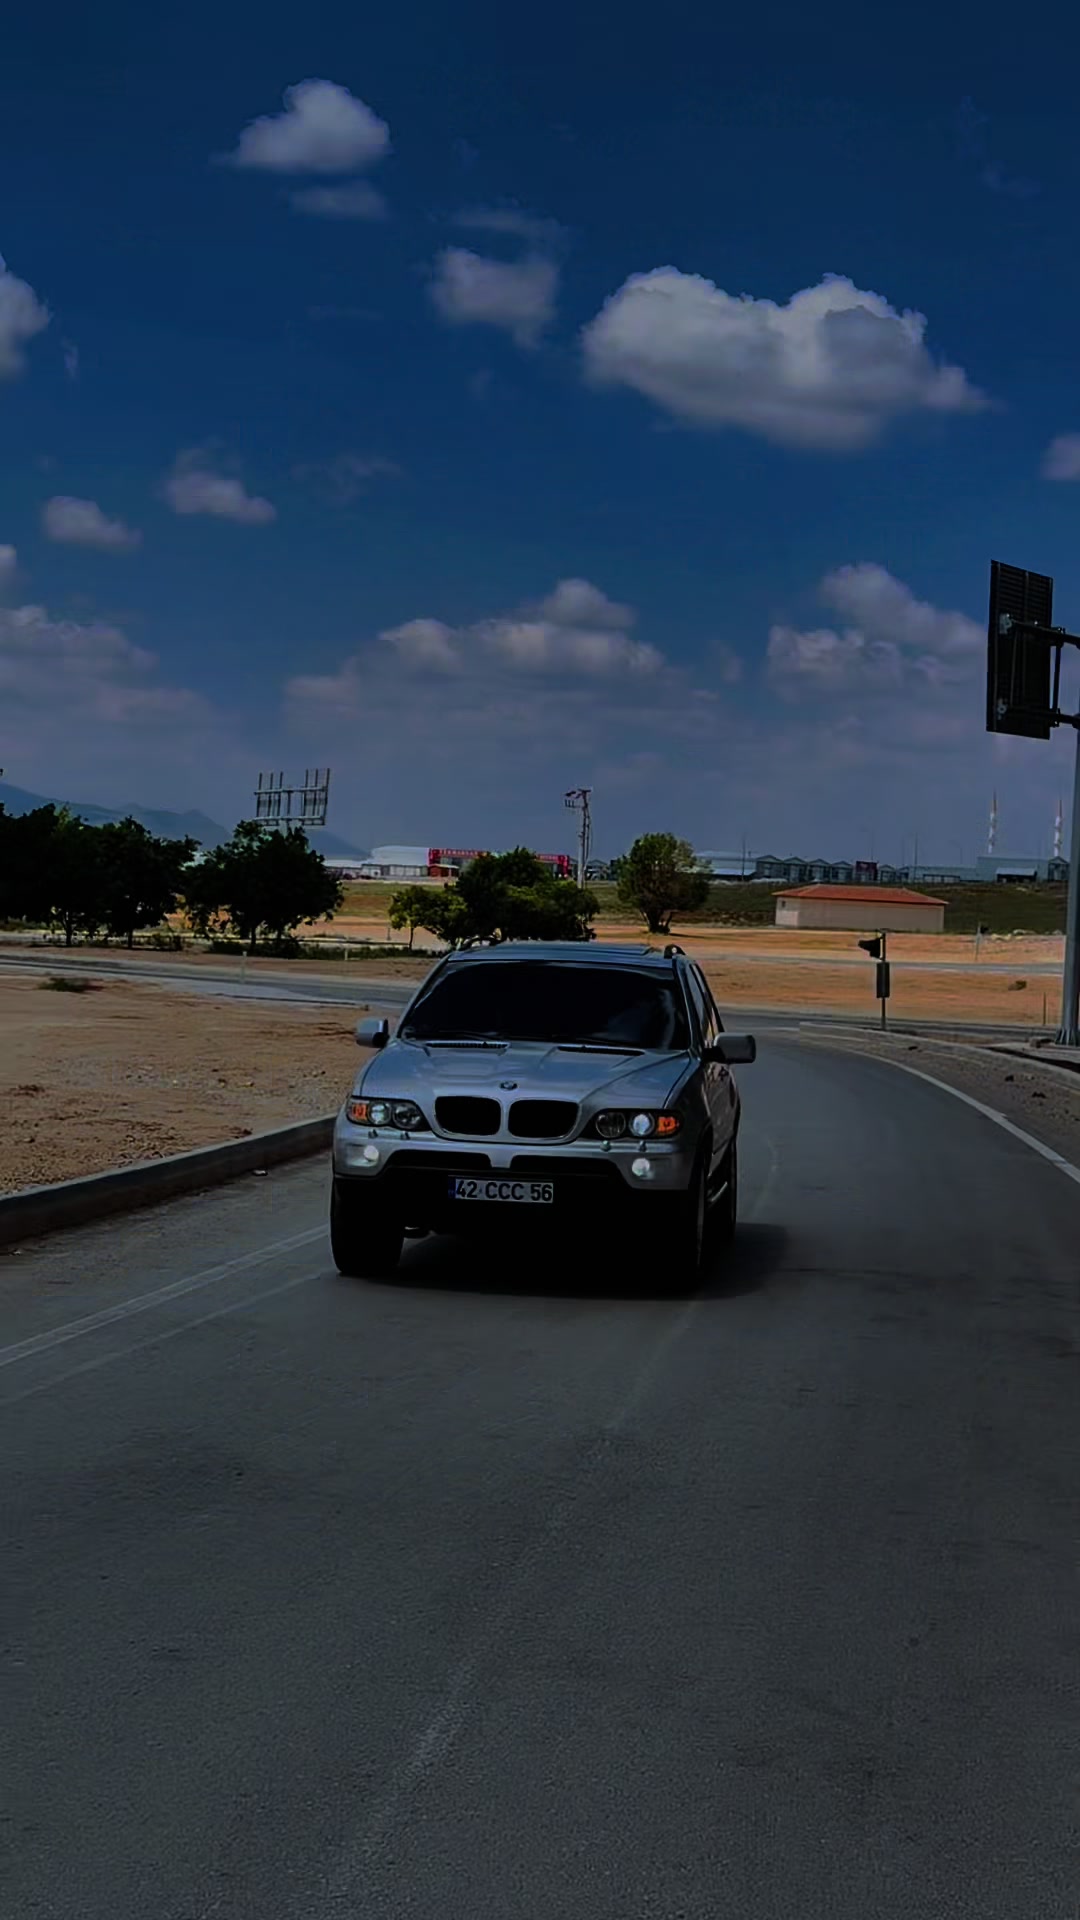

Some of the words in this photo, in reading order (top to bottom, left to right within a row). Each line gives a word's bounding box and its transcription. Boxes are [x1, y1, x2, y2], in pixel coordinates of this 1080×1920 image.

[456, 1180, 478, 1198] 42
[485, 1182, 524, 1200] CCC
[530, 1184, 553, 1202] 56
